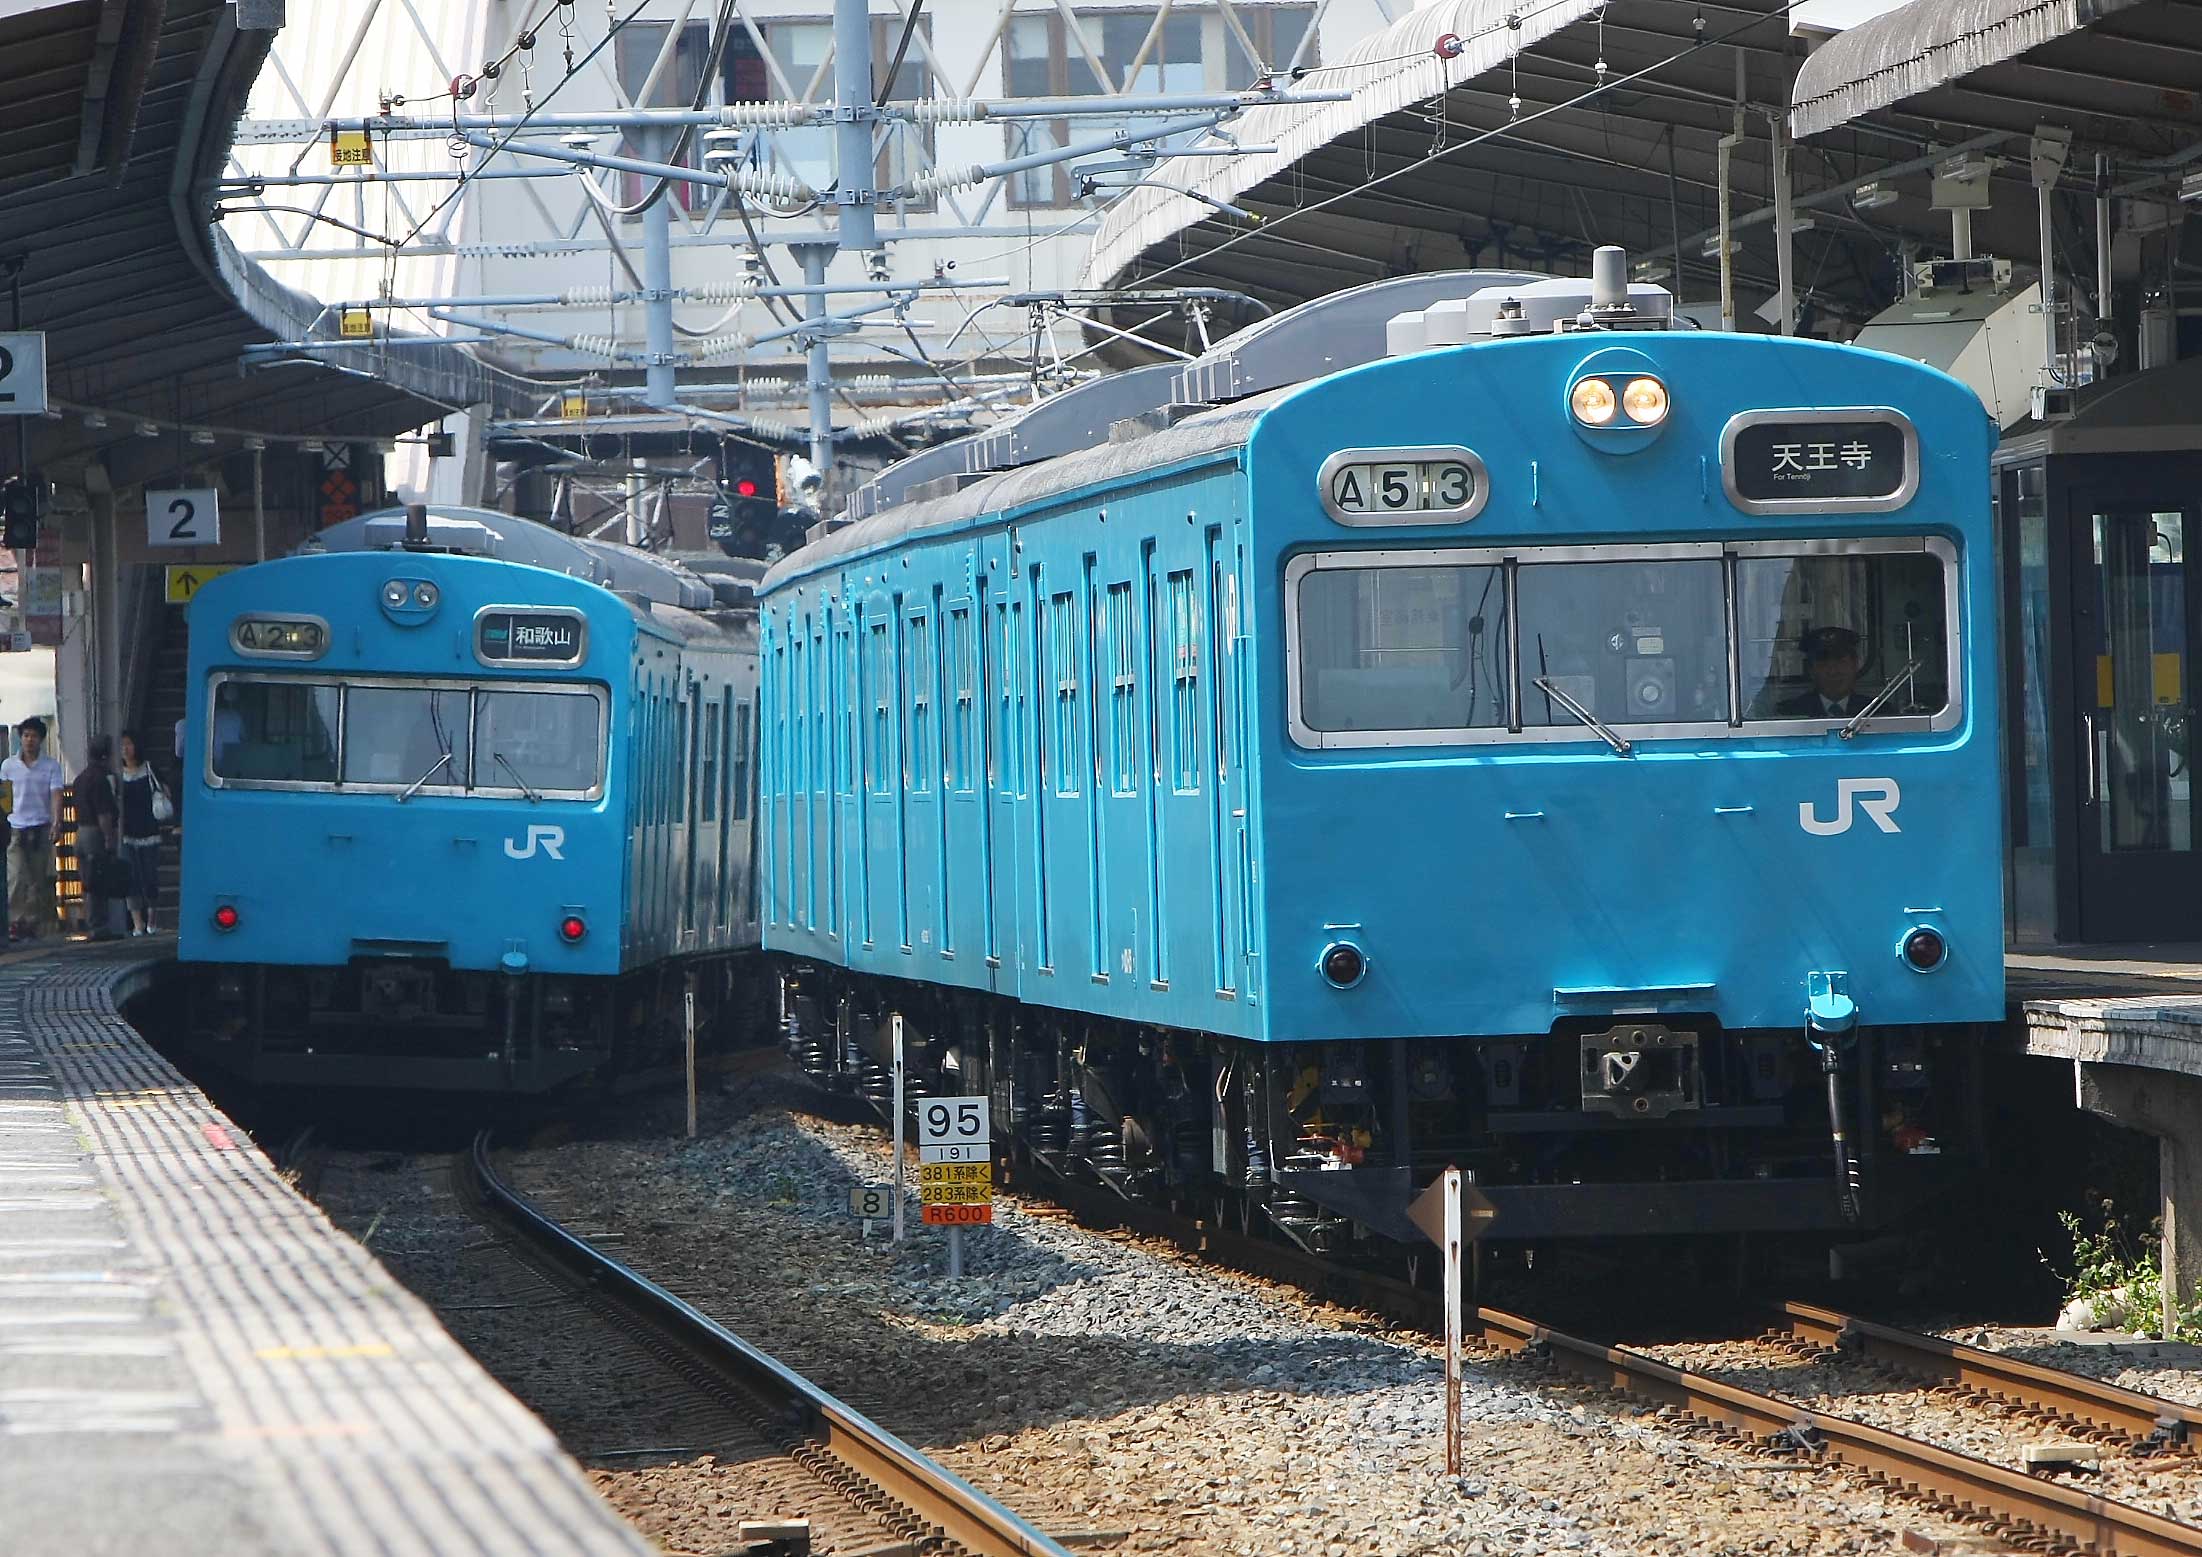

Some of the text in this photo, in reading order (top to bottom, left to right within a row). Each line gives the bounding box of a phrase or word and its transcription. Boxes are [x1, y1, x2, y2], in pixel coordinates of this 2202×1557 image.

[1772, 440, 1872, 472] 天王寺
[168, 499, 197, 539] 2
[515, 626, 571, 646] 和歌山
[1799, 777, 1902, 836] JR
[504, 824, 565, 860] JR
[927, 1104, 981, 1138] 95
[939, 1147, 970, 1160] 191
[922, 1165, 989, 1181] 381系除く
[862, 1192, 880, 1213] 8
[923, 1186, 989, 1201] 283系除く
[930, 1207, 983, 1222] R600
